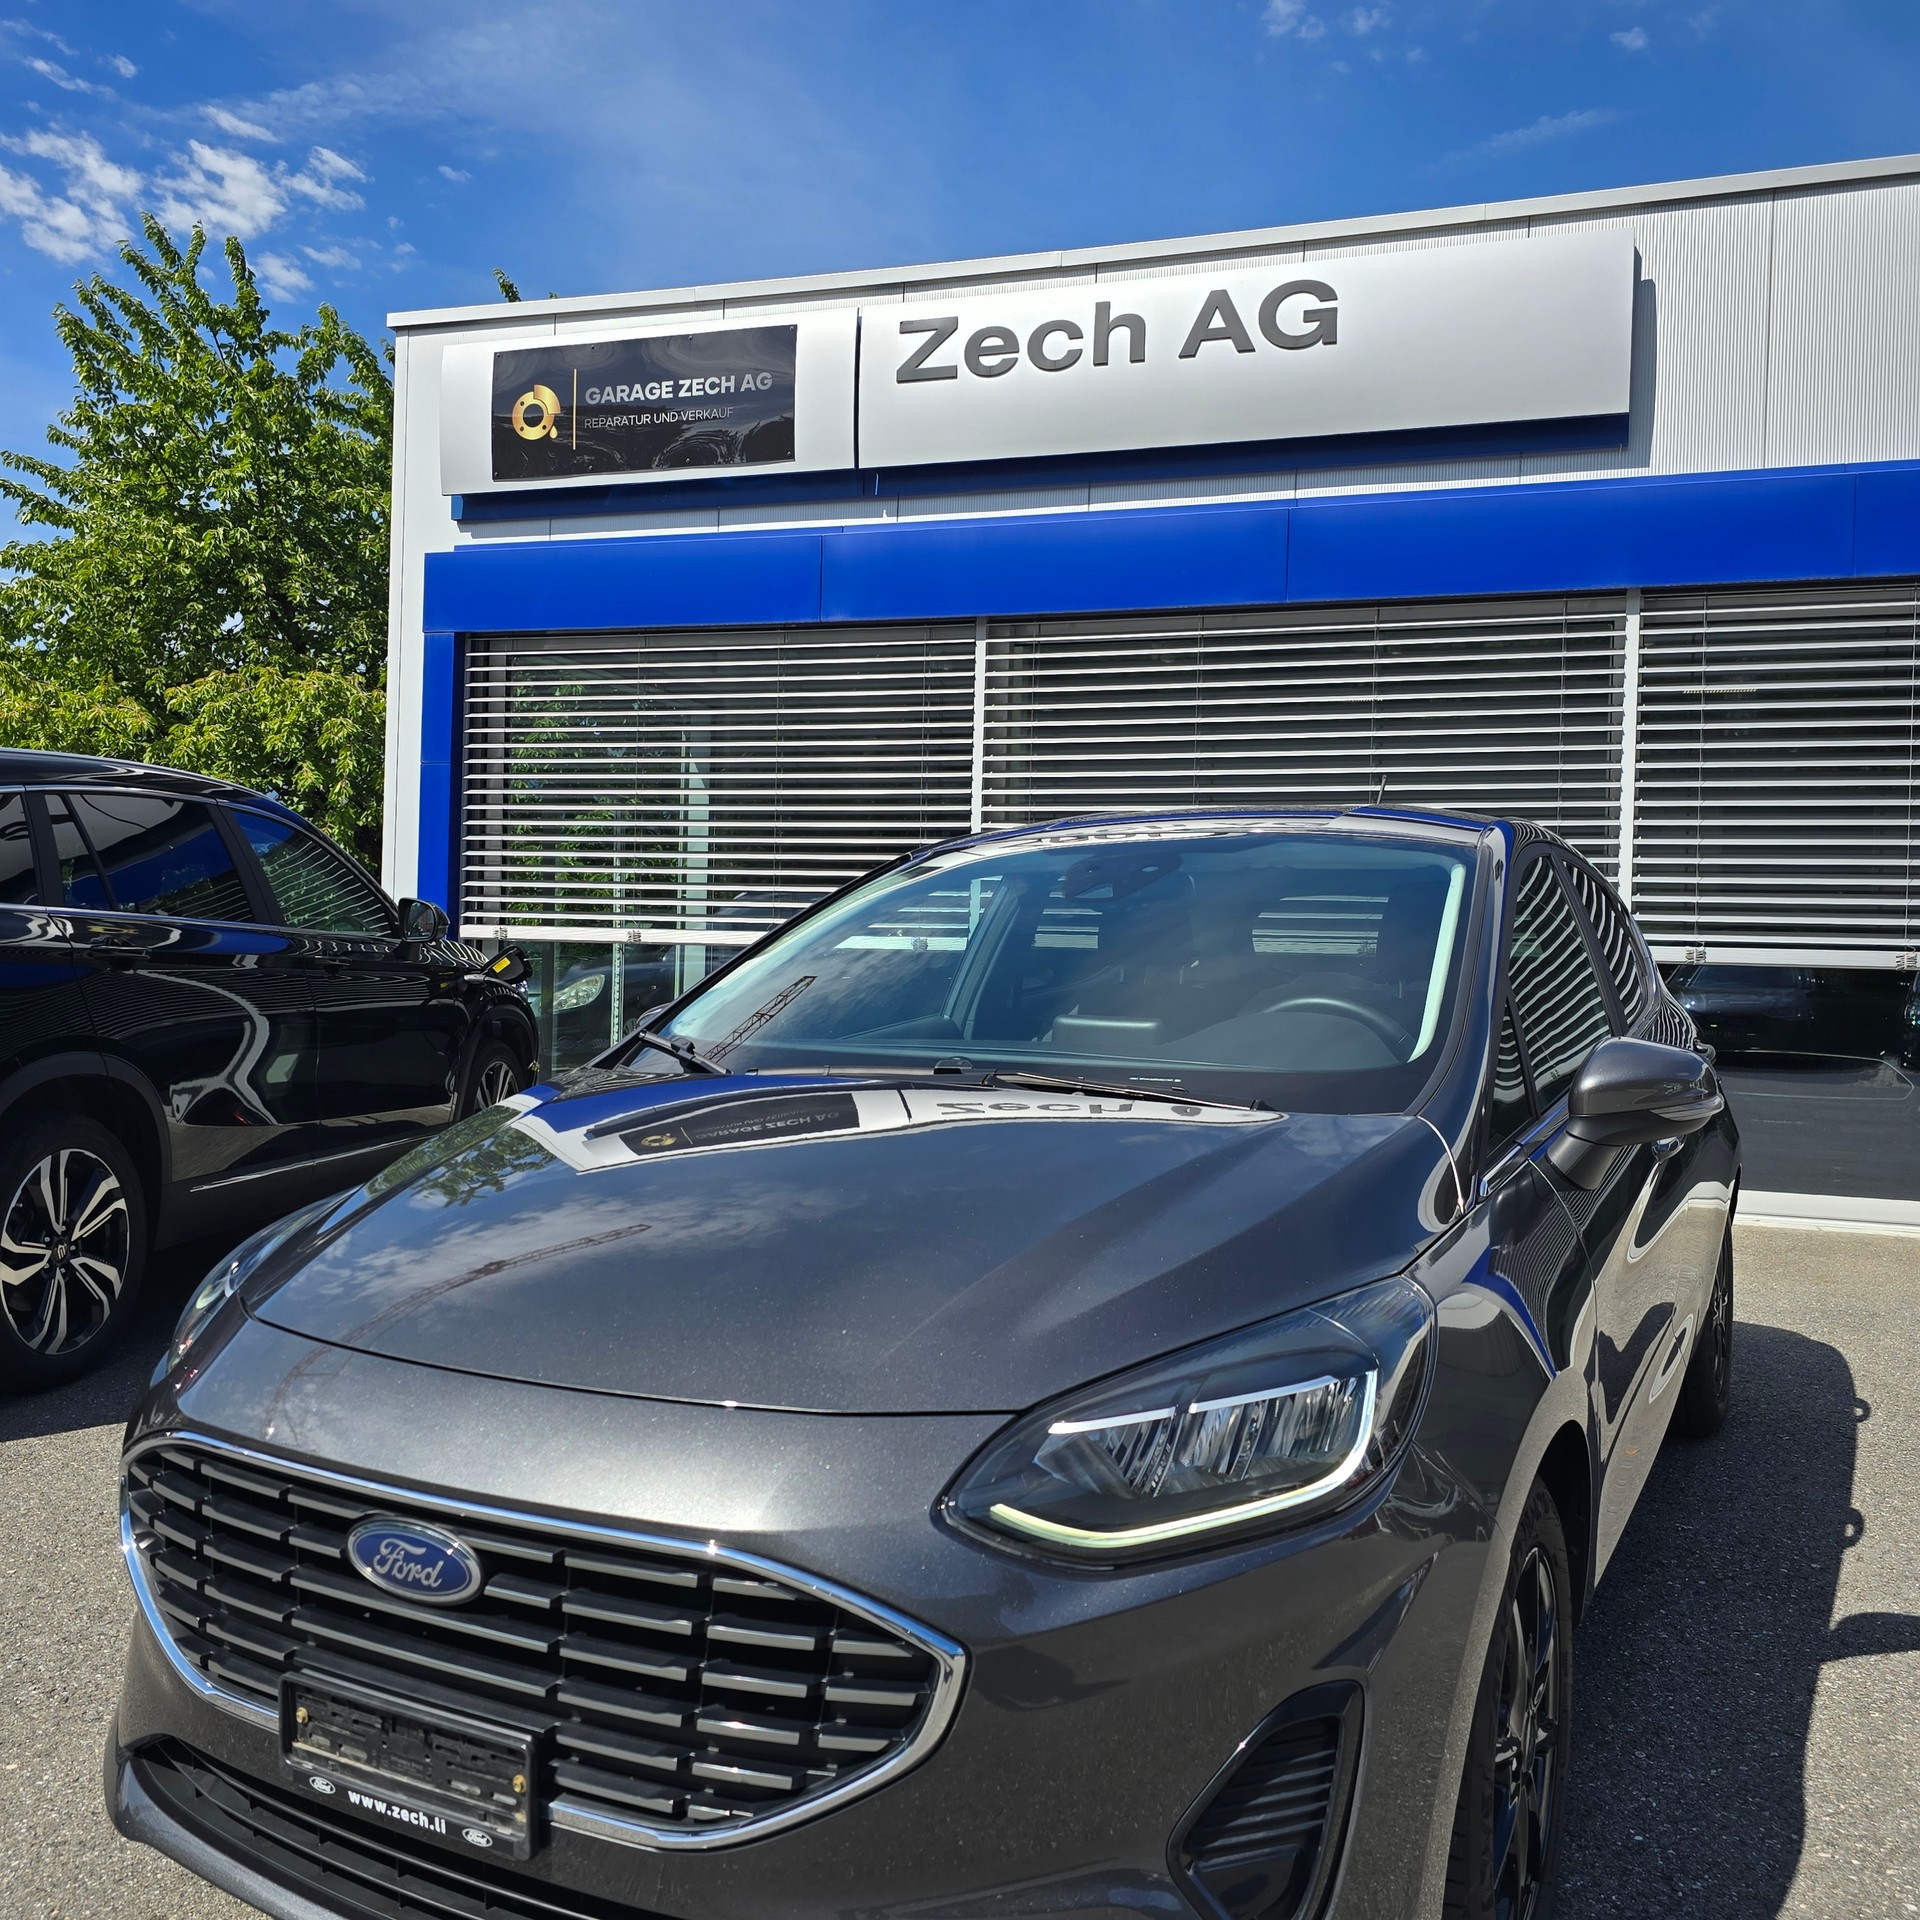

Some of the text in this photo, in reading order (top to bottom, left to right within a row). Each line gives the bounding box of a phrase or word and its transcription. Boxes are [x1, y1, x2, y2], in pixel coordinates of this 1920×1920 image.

[896, 279, 1338, 384] Zech AG
[585, 372, 773, 405] GARAGE ZECH AG
[584, 407, 734, 429] REPARATUR UND VERKAUF
[373, 1538, 444, 1587] Ford
[347, 1790, 446, 1834] www.zech.li
